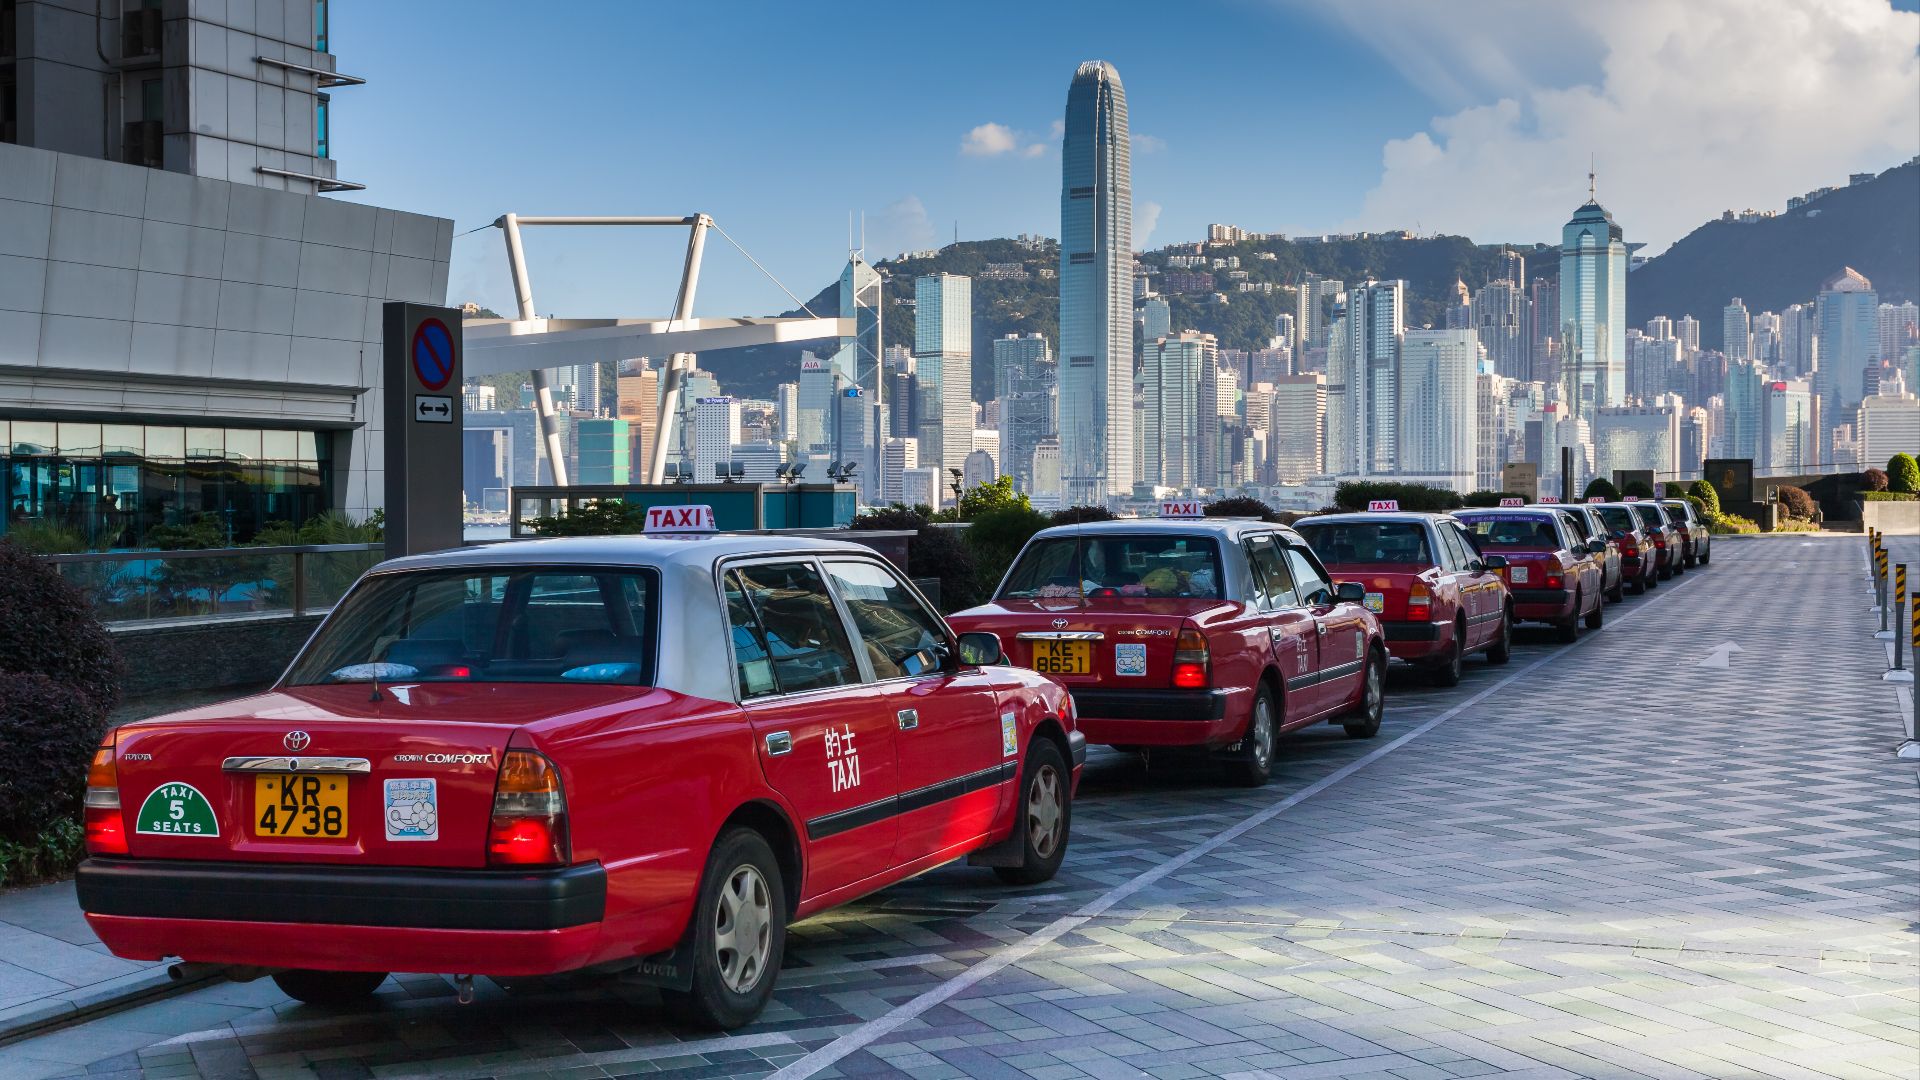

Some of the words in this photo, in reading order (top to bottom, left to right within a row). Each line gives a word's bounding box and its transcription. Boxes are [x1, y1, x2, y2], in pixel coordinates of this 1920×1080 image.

[1163, 503, 1197, 515] TAXI
[1370, 502, 1395, 510] TAXI
[649, 508, 701, 528] TAXI
[1050, 640, 1074, 657] KE
[1036, 656, 1083, 673] 8651
[825, 723, 857, 760] 的士
[124, 753, 152, 761] TOYOTA
[394, 754, 423, 762] CROWN
[424, 753, 492, 764] COMFORT
[827, 754, 861, 793] TAXI
[160, 786, 194, 801] TAXI
[280, 775, 321, 807] KR
[169, 799, 185, 820] 5
[152, 821, 202, 833] SEATS
[259, 804, 343, 836] 4738
